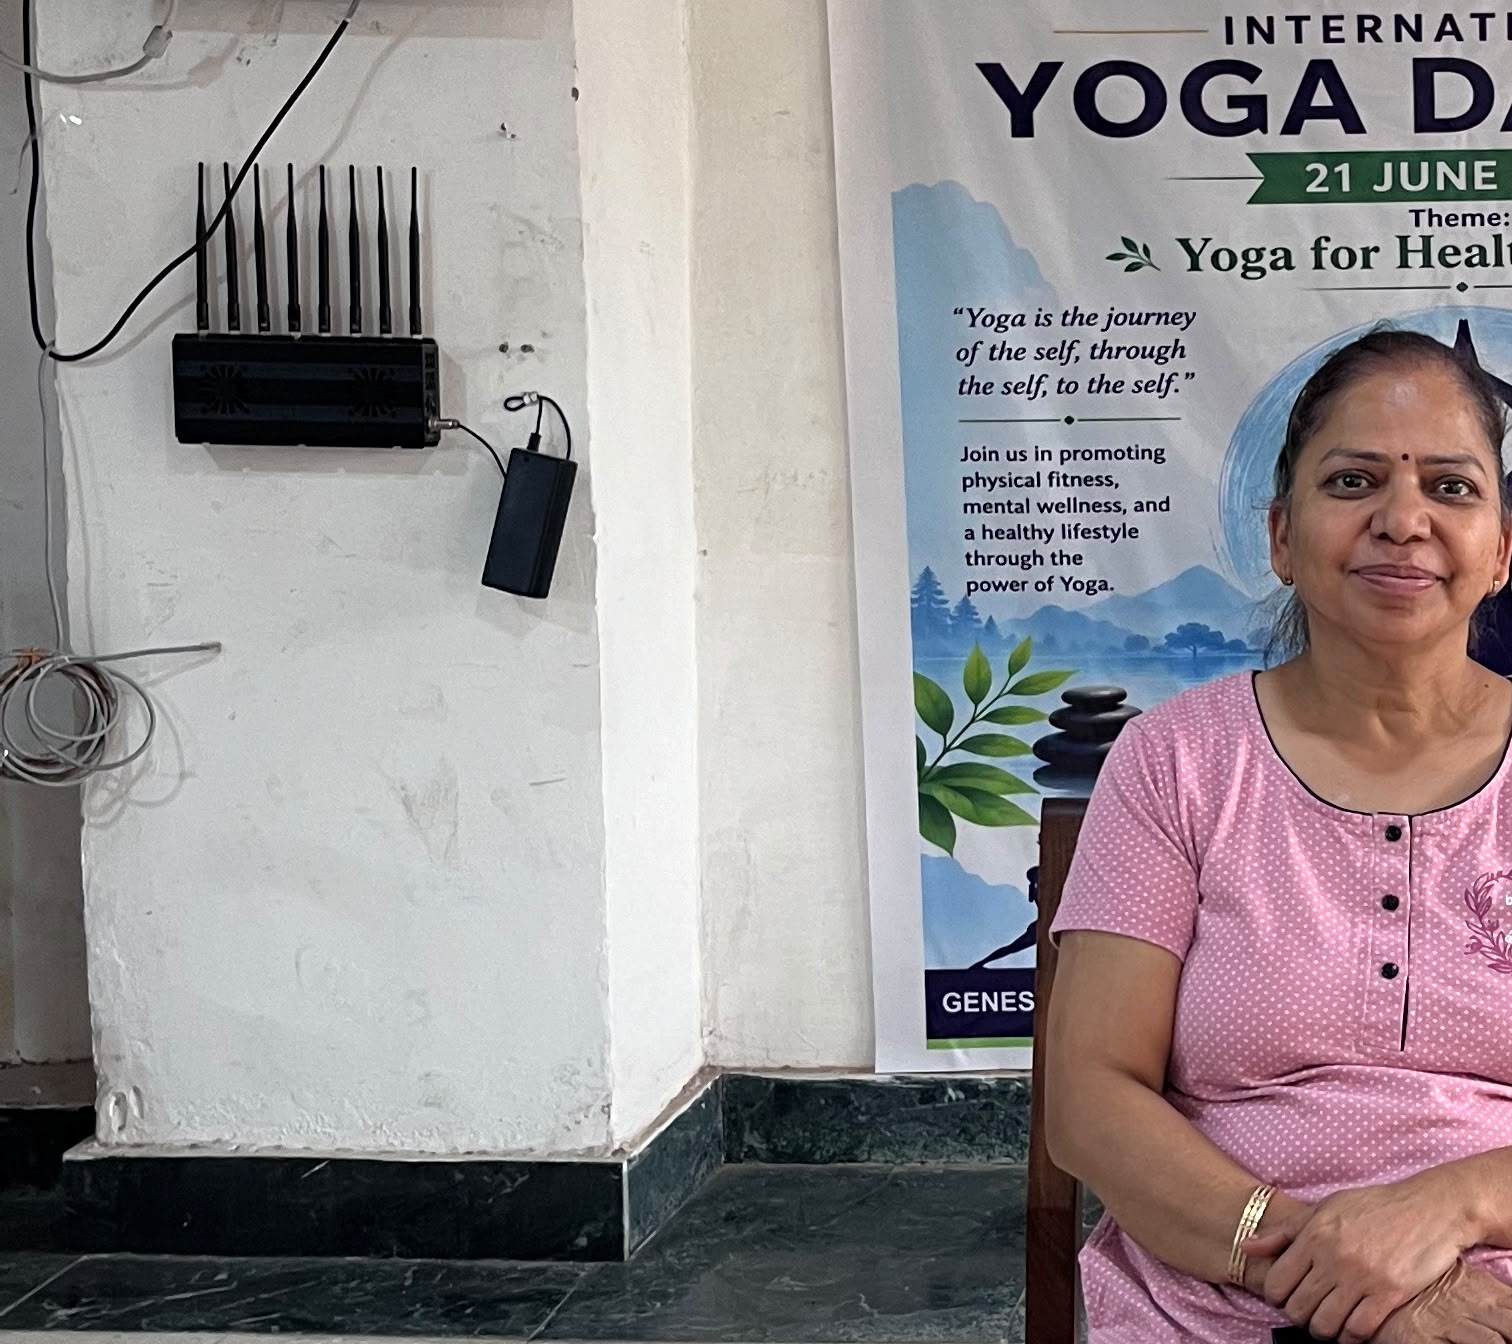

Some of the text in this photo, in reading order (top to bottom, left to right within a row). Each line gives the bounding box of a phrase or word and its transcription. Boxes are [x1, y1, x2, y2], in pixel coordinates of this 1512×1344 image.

[975, 58, 1367, 139] YOGA
[1304, 163, 1352, 194] 21
[1372, 160, 1498, 193] JUNE
[1408, 209, 1511, 229] Theme:
[1175, 237, 1296, 280] Yoga
[1310, 235, 1380, 271] for
[1034, 307, 1053, 327] is
[1060, 306, 1099, 327] the
[1101, 307, 1197, 332] journey
[955, 338, 1187, 367] of the self, through
[958, 375, 995, 395] the
[1000, 373, 1050, 400] self,
[1056, 375, 1080, 395] to
[1086, 374, 1125, 394] the
[960, 444, 1167, 465] Join us in promoting
[962, 470, 1120, 492] physical fitness,
[962, 496, 1171, 516] mental wellness, and
[964, 522, 1140, 544] a healthy lifestyle
[965, 549, 1084, 570] through the
[966, 575, 1115, 597] power of Yoga.
